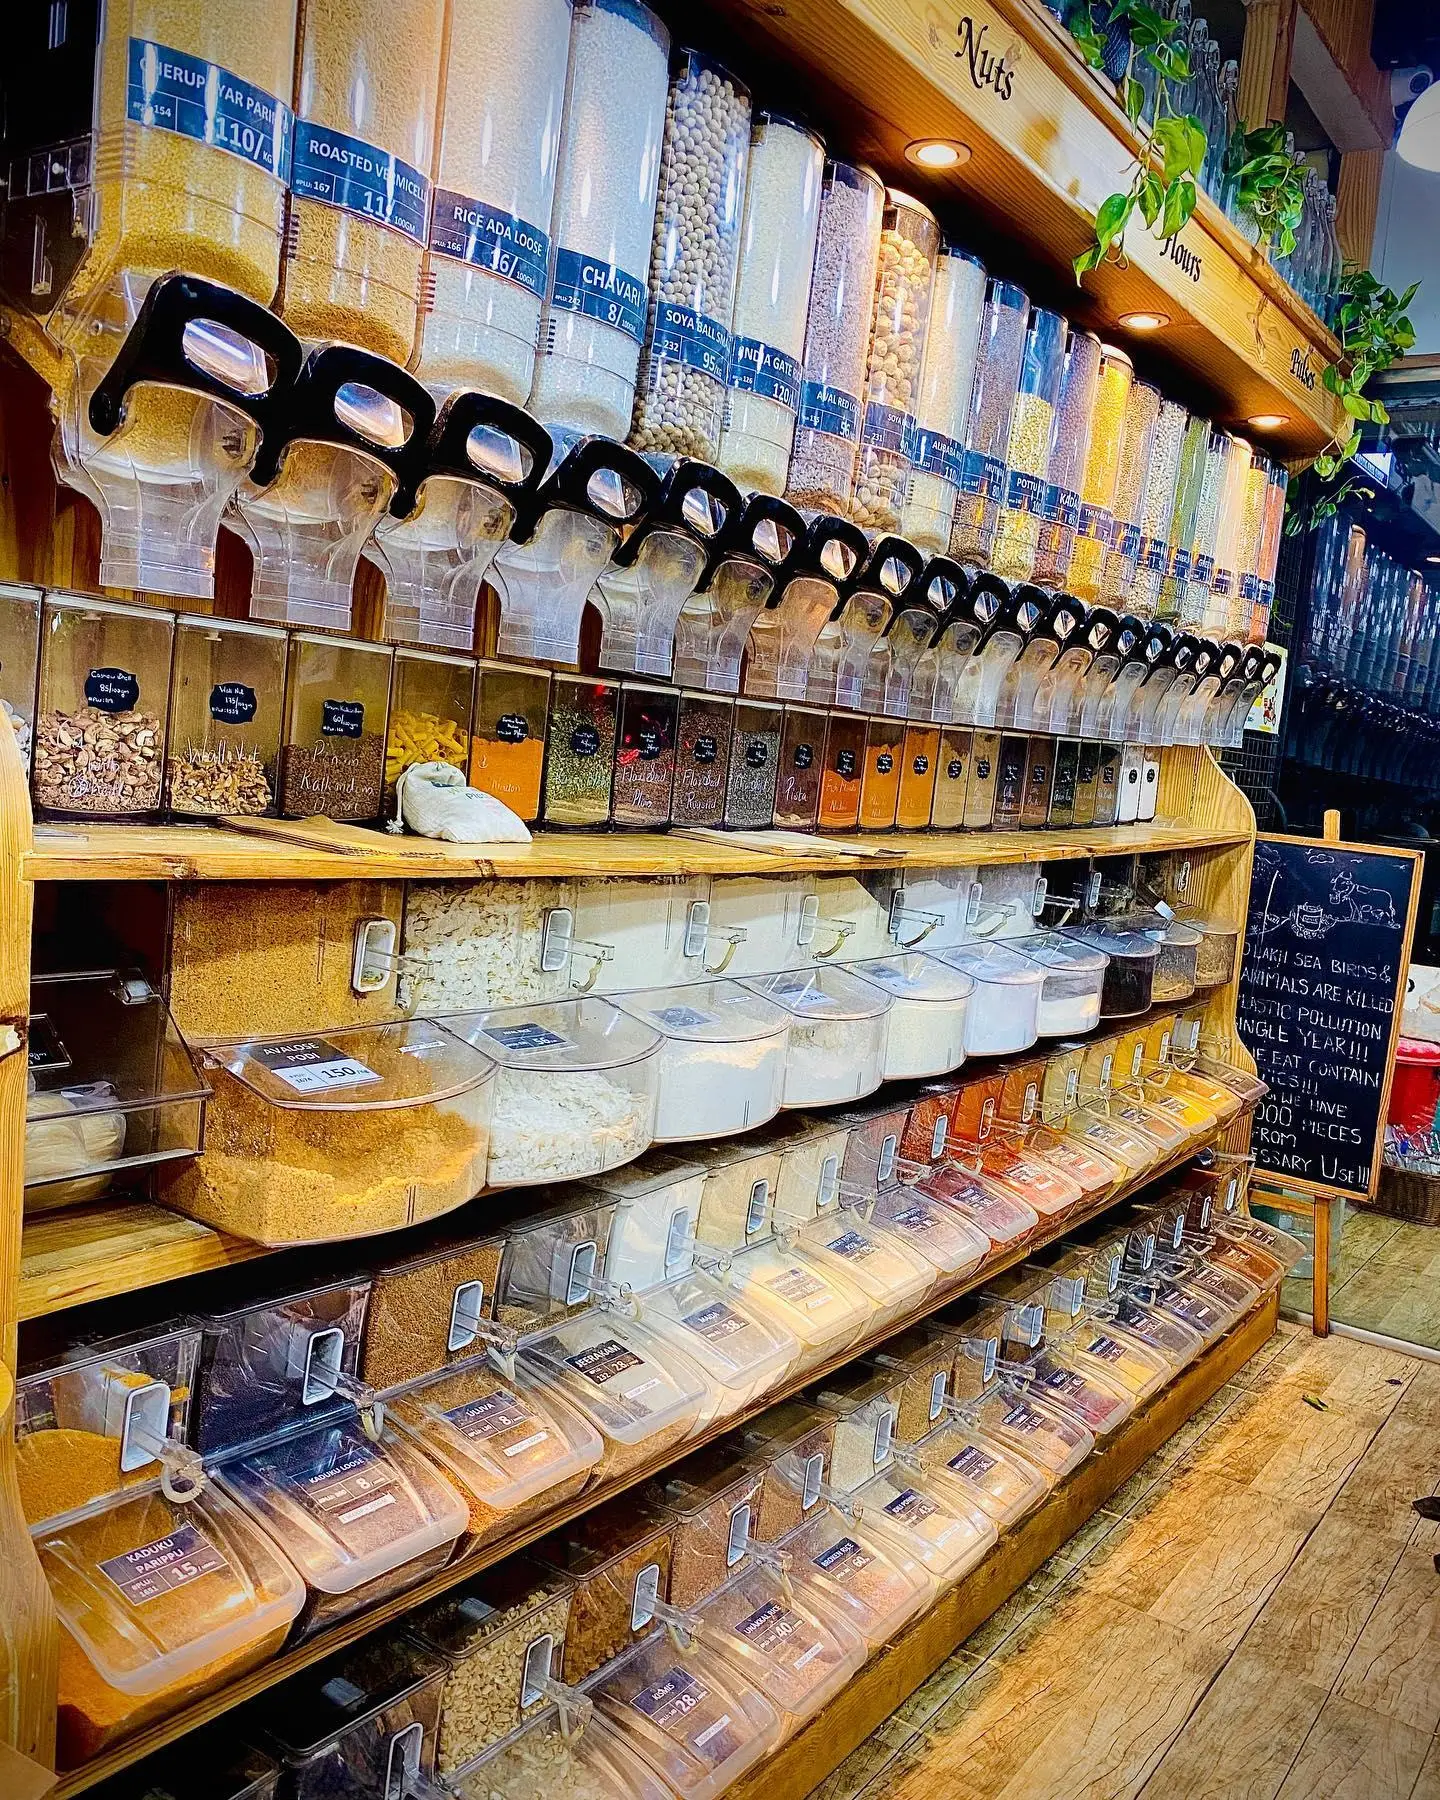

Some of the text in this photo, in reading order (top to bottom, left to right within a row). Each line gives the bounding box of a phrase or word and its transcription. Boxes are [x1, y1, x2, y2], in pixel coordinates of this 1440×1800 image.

[954, 17, 1014, 101] Nuts
[309, 139, 373, 173] ROASTED
[313, 181, 331, 194] 167
[453, 206, 544, 258] RICE ADA LOOSE
[446, 240, 462, 252] 166
[582, 265, 641, 308] CHAVARI
[665, 309, 695, 331] SOYA
[696, 321, 715, 340] BALL
[664, 340, 680, 353] 232
[772, 357, 793, 378] GATE
[817, 390, 836, 405] AVAL
[837, 398, 850, 412] RED
[887, 413, 902, 425] SOYA
[871, 432, 883, 442] 231
[1016, 477, 1038, 492] POTTU
[785, 776, 808, 802] Pista
[1293, 952, 1322, 970] SEA
[1331, 959, 1378, 981] BIRDS
[1379, 964, 1392, 984] &
[1240, 966, 1394, 1014] ANIMALS ARE KILLED
[1238, 993, 1382, 1040] LASTIC POLLUTION
[263, 1042, 320, 1056] AVALOSE
[286, 1052, 321, 1063] PODI
[321, 1066, 356, 1079] 150
[1271, 1050, 1302, 1069] EAT
[1308, 1060, 1380, 1089] CONTAIN
[1310, 1098, 1349, 1119] HAVE
[1251, 1126, 1297, 1148] FROM
[1302, 1119, 1363, 1145] PIECES
[697, 1311, 720, 1323] MAIDA
[721, 1319, 740, 1333] 38
[575, 1344, 621, 1368] JEERAKAM
[596, 1372, 611, 1382] 132
[465, 1403, 496, 1417] ULUVA
[308, 1457, 365, 1484] KADUKU LOOSE
[125, 1538, 175, 1563] KADUKU
[135, 1548, 175, 1574] PARIPPU
[769, 1604, 782, 1618] RICE
[651, 1682, 676, 1701] KISMIS
